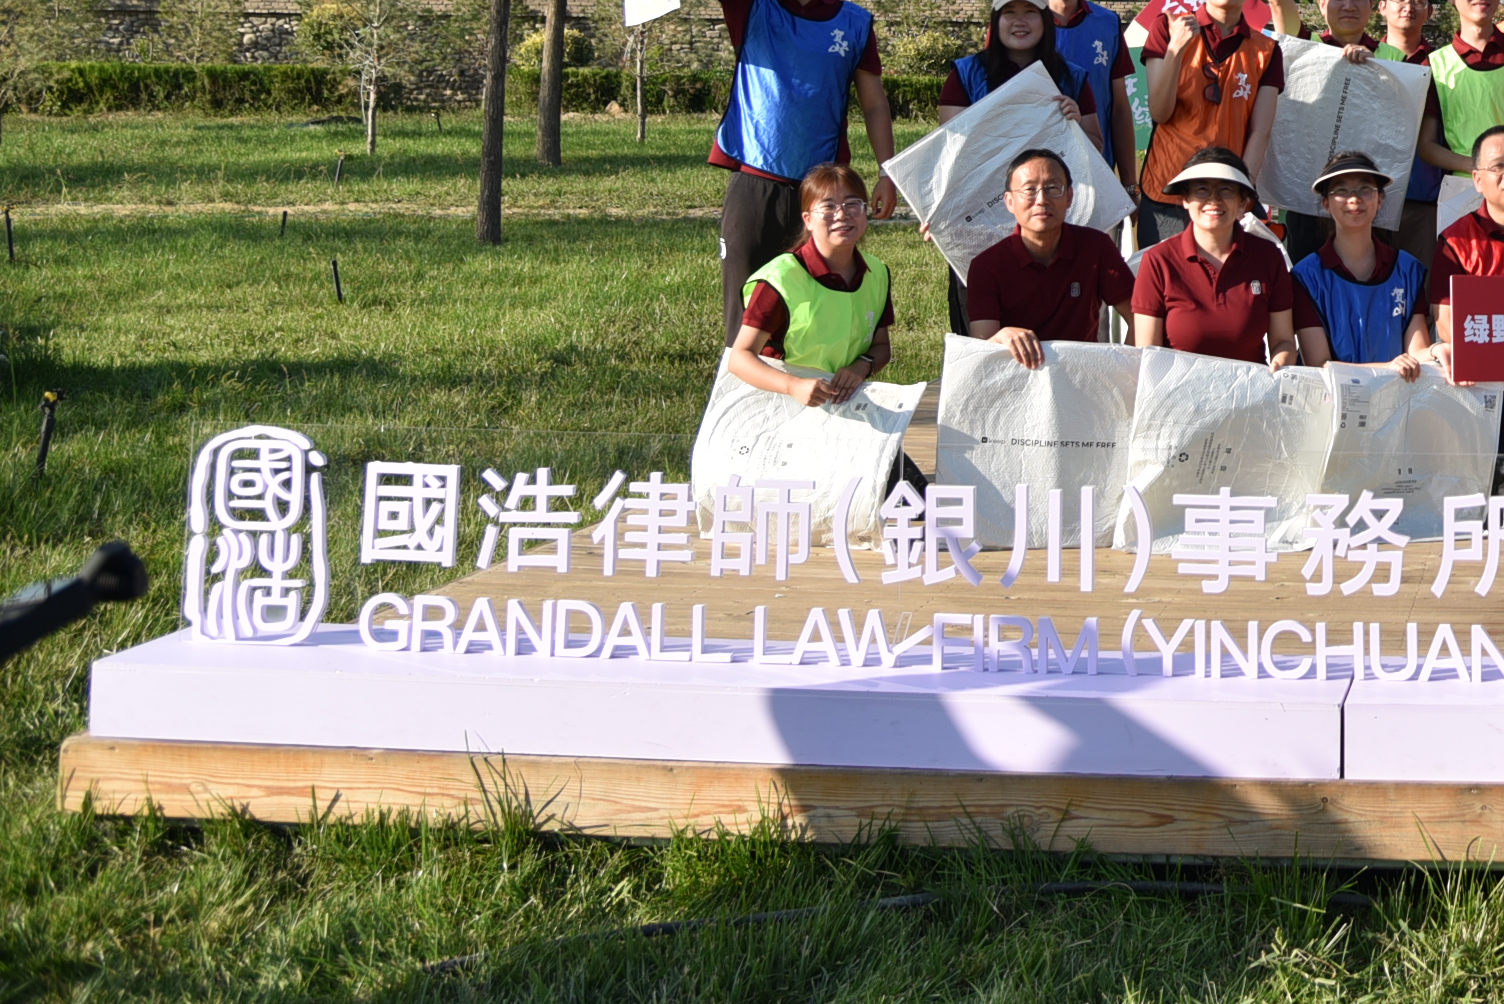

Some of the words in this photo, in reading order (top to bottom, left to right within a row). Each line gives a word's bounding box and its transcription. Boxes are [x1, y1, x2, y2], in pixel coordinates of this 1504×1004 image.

[1342, 77, 1351, 94] FREE
[1340, 95, 1347, 105] ME
[1336, 106, 1344, 123] SETS
[1328, 123, 1340, 161] DISCIPLINE
[1010, 438, 1059, 447] DISCIPLINE
[358, 592, 733, 664] GRANDALL
[753, 605, 931, 668] LAW
[932, 612, 1099, 676] FIRM
